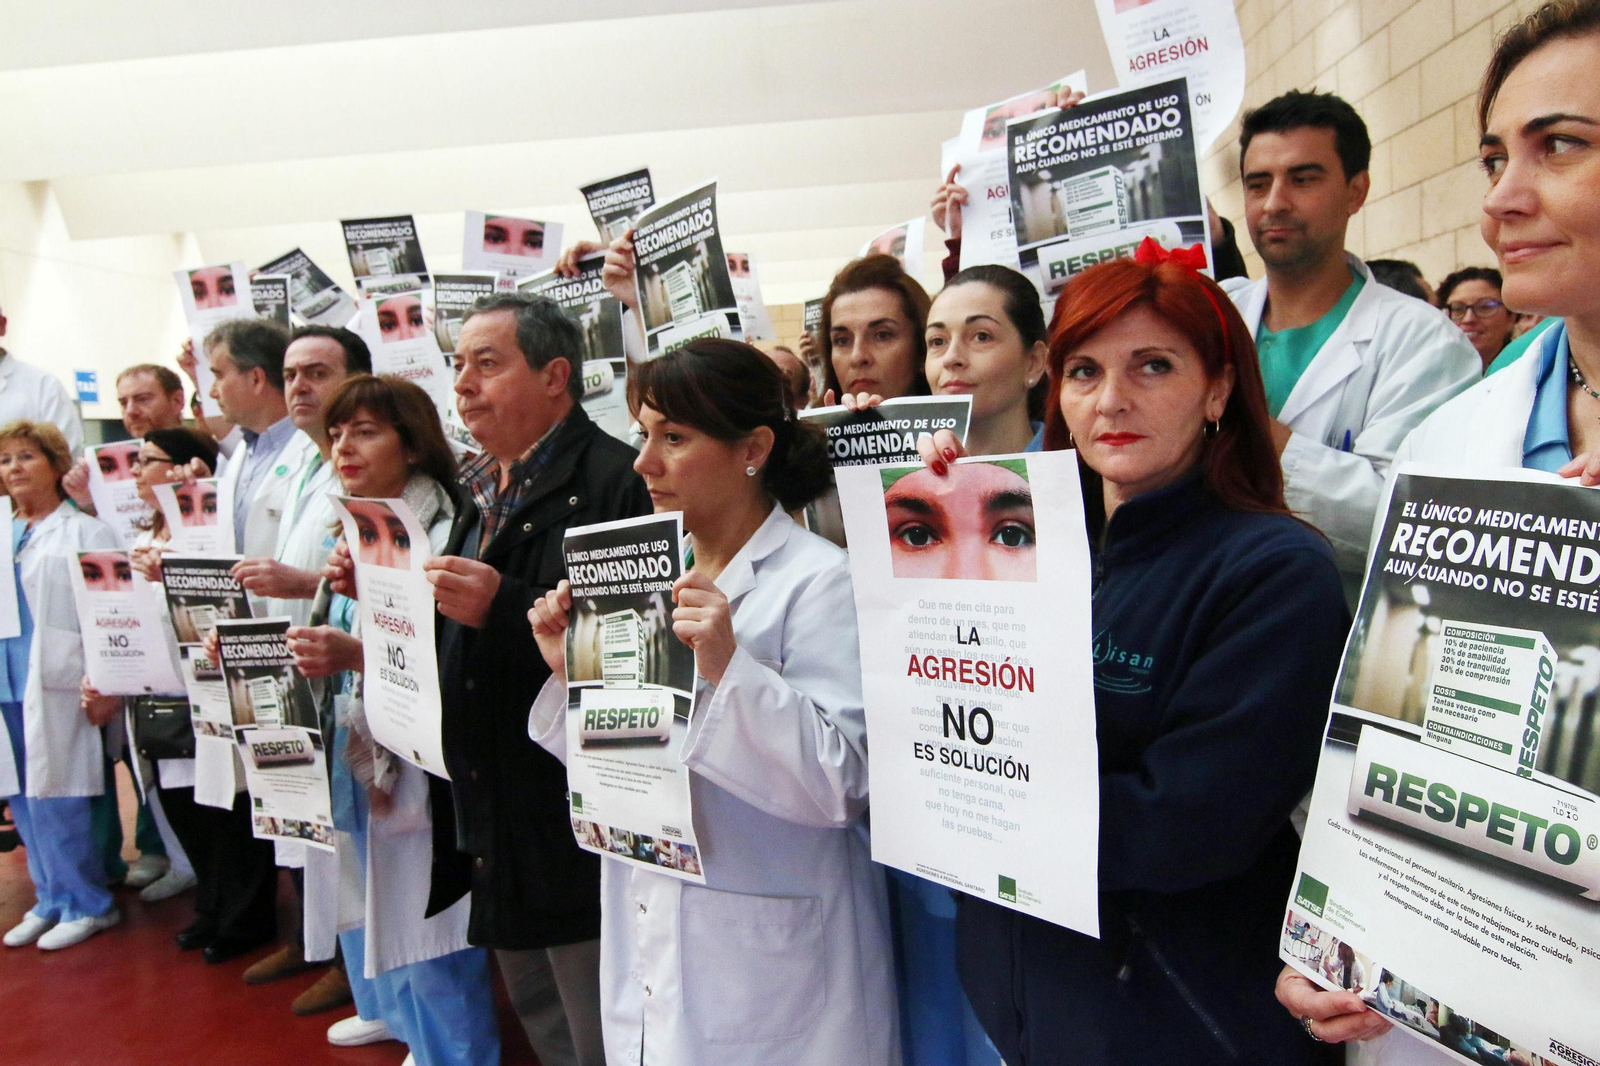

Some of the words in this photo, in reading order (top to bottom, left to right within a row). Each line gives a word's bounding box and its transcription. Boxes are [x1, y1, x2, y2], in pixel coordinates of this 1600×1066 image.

[1153, 28, 1171, 41] LA
[1129, 37, 1209, 72] AGRESIÓN
[1014, 135, 1024, 145] EL
[1026, 125, 1057, 142] ÚNICO
[1058, 105, 1136, 133] MEDICAMENTO
[1138, 101, 1152, 113] DE
[1154, 94, 1179, 109] USO
[1014, 107, 1181, 164] RECOMENDADO
[1016, 162, 1036, 174] AUN
[1037, 151, 1078, 169] CUANDO
[1080, 147, 1097, 159] NO
[1099, 144, 1110, 154] SE
[1112, 136, 1134, 152] ESTÉ
[1135, 127, 1183, 146] ENFERMO
[634, 208, 714, 257] RECOMENDADO
[843, 419, 911, 435] MEDICAMENTO
[913, 419, 928, 429] DE
[931, 418, 957, 429] USO
[1402, 501, 1418, 518] EL
[1421, 499, 1472, 523] ÚNICO
[1474, 509, 1600, 542] MEDICAMEN
[589, 544, 639, 560] MEDICAMENTO
[639, 542, 650, 554] DE
[650, 539, 669, 553] USO
[1389, 522, 1600, 585] RECOMEND
[568, 554, 672, 585] RECOMENDADO
[584, 586, 609, 597] CUANDO
[609, 584, 621, 594] NO
[621, 584, 629, 594] SE
[629, 580, 643, 593] ESTÉ
[1383, 558, 1417, 577] AUN
[1418, 563, 1487, 591] CUANDO
[1492, 577, 1525, 598] NO
[1529, 584, 1552, 604] SE
[1556, 589, 1600, 613] ESTÉ
[384, 594, 394, 608] LA
[918, 598, 936, 610] Que
[938, 602, 952, 611] me
[955, 602, 972, 612] den
[975, 602, 992, 613] cita
[994, 605, 1014, 615] para
[373, 612, 416, 639] AGRESIÓN
[908, 614, 937, 625] dentro
[939, 616, 950, 626] de
[953, 619, 965, 628] un
[992, 621, 1010, 633] que
[1012, 623, 1026, 633] me
[108, 635, 129, 648] NO
[908, 630, 947, 642] atiendan
[1009, 640, 1027, 651] que
[957, 625, 981, 646] LA
[1444, 638, 1457, 648] 10%
[1459, 641, 1468, 649] de
[1468, 642, 1504, 656] paciencia
[1445, 628, 1497, 643] COMPOSICIÓN
[387, 643, 405, 670] NO
[904, 643, 920, 654] aún
[923, 647, 935, 656] no
[937, 648, 962, 660] estén
[964, 650, 978, 660] los
[1443, 647, 1456, 656] 10%
[1457, 649, 1466, 658] de
[1467, 651, 1506, 666] amabilidad
[907, 654, 1035, 693] AGRESIÓN
[1439, 664, 1454, 674] 50%
[1455, 666, 1464, 676] de
[1465, 669, 1511, 686] comprensión
[1441, 655, 1455, 665] 30%
[1456, 658, 1465, 666] de
[1467, 660, 1511, 677] tranquilidad
[388, 670, 419, 693] SOLUCIÓN
[915, 676, 935, 687] que
[969, 683, 981, 692] no
[1435, 686, 1456, 697] DOSIS
[935, 695, 952, 706] que
[954, 696, 966, 706] no
[969, 698, 1003, 712] puedan
[1431, 706, 1443, 715] sea
[1444, 708, 1478, 723] necesario
[1433, 696, 1454, 709] Tantas
[1456, 703, 1476, 714] veces
[1477, 709, 1496, 719] como
[584, 706, 660, 730] RESPETO
[942, 702, 994, 746] NO
[1012, 723, 1030, 735] que
[252, 739, 304, 757] RESPETO
[1426, 731, 1452, 745] Ninguna
[1428, 721, 1504, 752] CONTRAINDICACIONES
[914, 741, 935, 761] ES
[939, 746, 1030, 782] SOLUCIÓN
[920, 767, 962, 784] suficiente
[964, 778, 1006, 796] personal,
[1008, 788, 1027, 800] que
[938, 787, 950, 797] no
[952, 789, 977, 805] tenga
[978, 797, 1006, 812] cama,
[925, 799, 941, 811] que
[943, 802, 960, 818] hoy
[962, 808, 974, 819] no
[976, 812, 990, 823] me
[991, 815, 1021, 832] hagan
[942, 818, 955, 830] las
[1327, 818, 1341, 830] Cada
[1342, 826, 1351, 836] vez
[1351, 829, 1362, 842] hay
[1362, 835, 1374, 847] más
[1374, 842, 1404, 862] agresiones
[1404, 857, 1412, 866] al
[1411, 862, 1437, 878] personal
[1438, 873, 1466, 894] sanitario.
[1466, 888, 1503, 912] Agresiones
[1526, 920, 1534, 929] y,
[1535, 923, 1557, 939] sobre
[1558, 934, 1579, 951] todo,
[1358, 849, 1368, 859] Las
[1368, 855, 1400, 876] enfermeras
[1437, 890, 1447, 900] de
[1447, 896, 1460, 907] este
[1460, 903, 1480, 918] centro
[1481, 912, 1520, 939] trabajamos
[1521, 935, 1539, 950] para
[1541, 943, 1573, 965] cuidarle
[1383, 873, 1389, 881] el
[1389, 878, 1410, 892] respeto
[1429, 897, 1446, 911] debe
[1445, 906, 1456, 917] ser
[1456, 911, 1463, 922] la
[1463, 916, 1480, 931] base
[1480, 924, 1490, 936] de
[1490, 930, 1505, 944] esta
[1506, 939, 1538, 961] relación.
[1383, 890, 1423, 917] Mantengamos
[1423, 912, 1432, 922] un
[1432, 915, 1449, 931] clima
[1450, 926, 1481, 950] saludable
[1481, 945, 1499, 959] para
